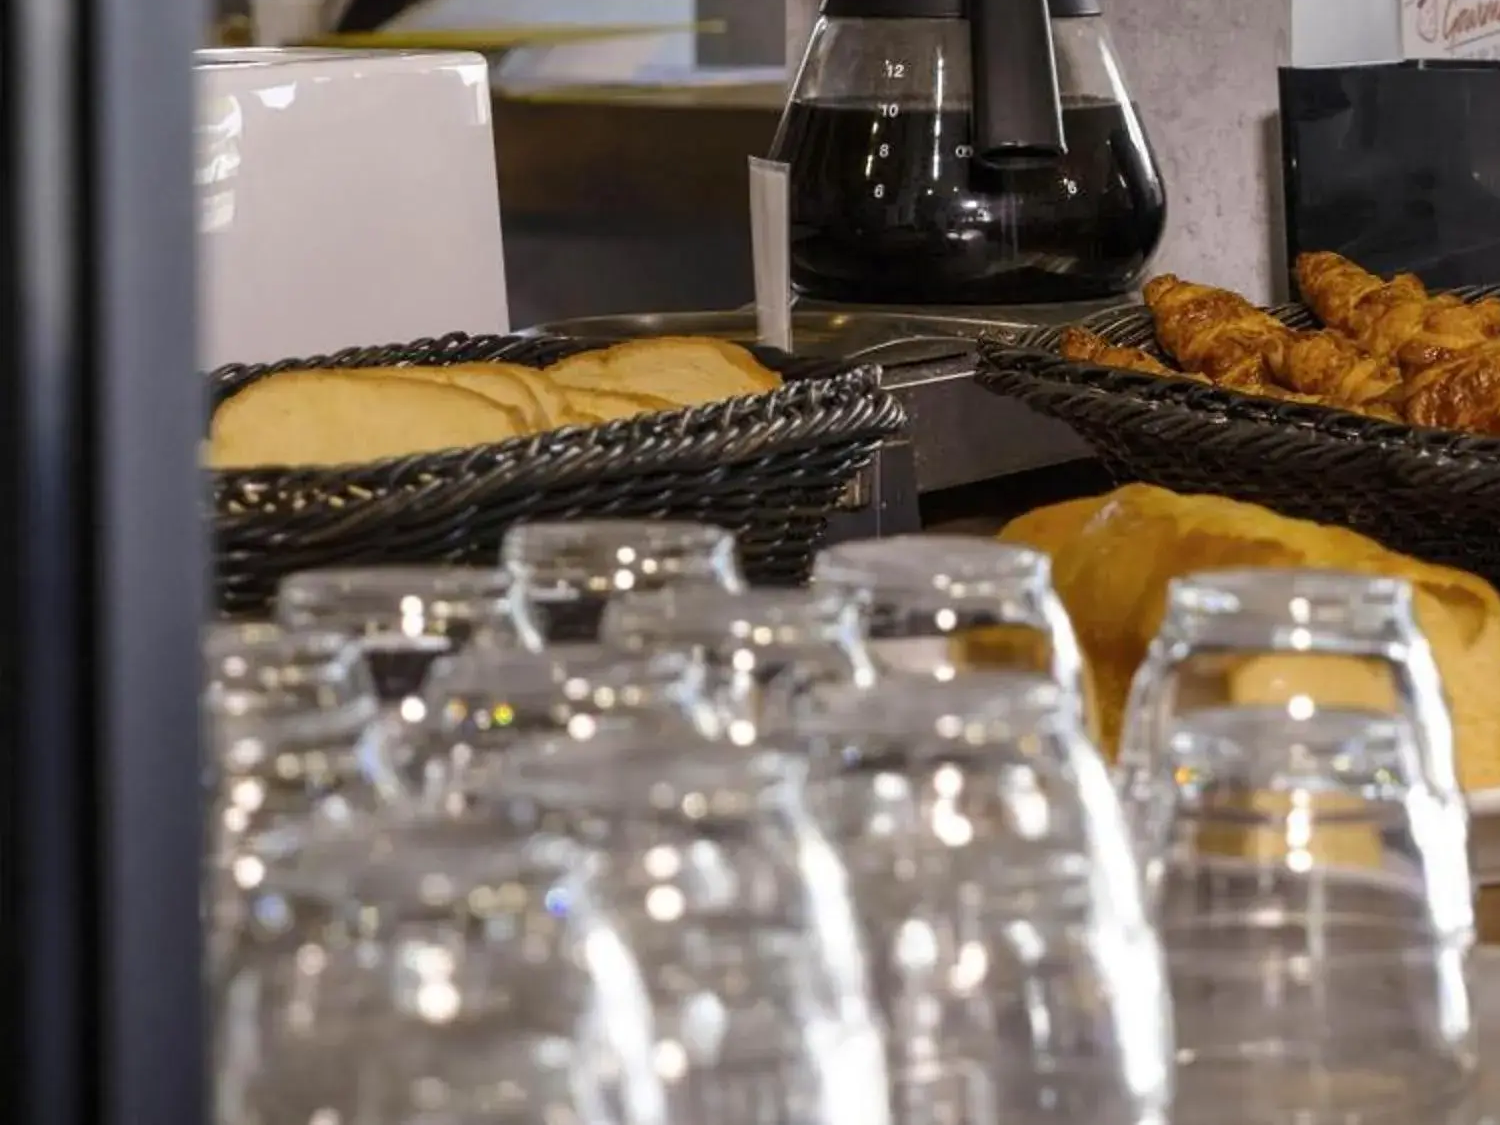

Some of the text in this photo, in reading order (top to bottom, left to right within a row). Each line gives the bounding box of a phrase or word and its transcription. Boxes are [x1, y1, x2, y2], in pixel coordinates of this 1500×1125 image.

[887, 63, 905, 78] 12
[880, 103, 899, 118] 10
[879, 143, 889, 158] 8
[874, 183, 885, 198] 6
